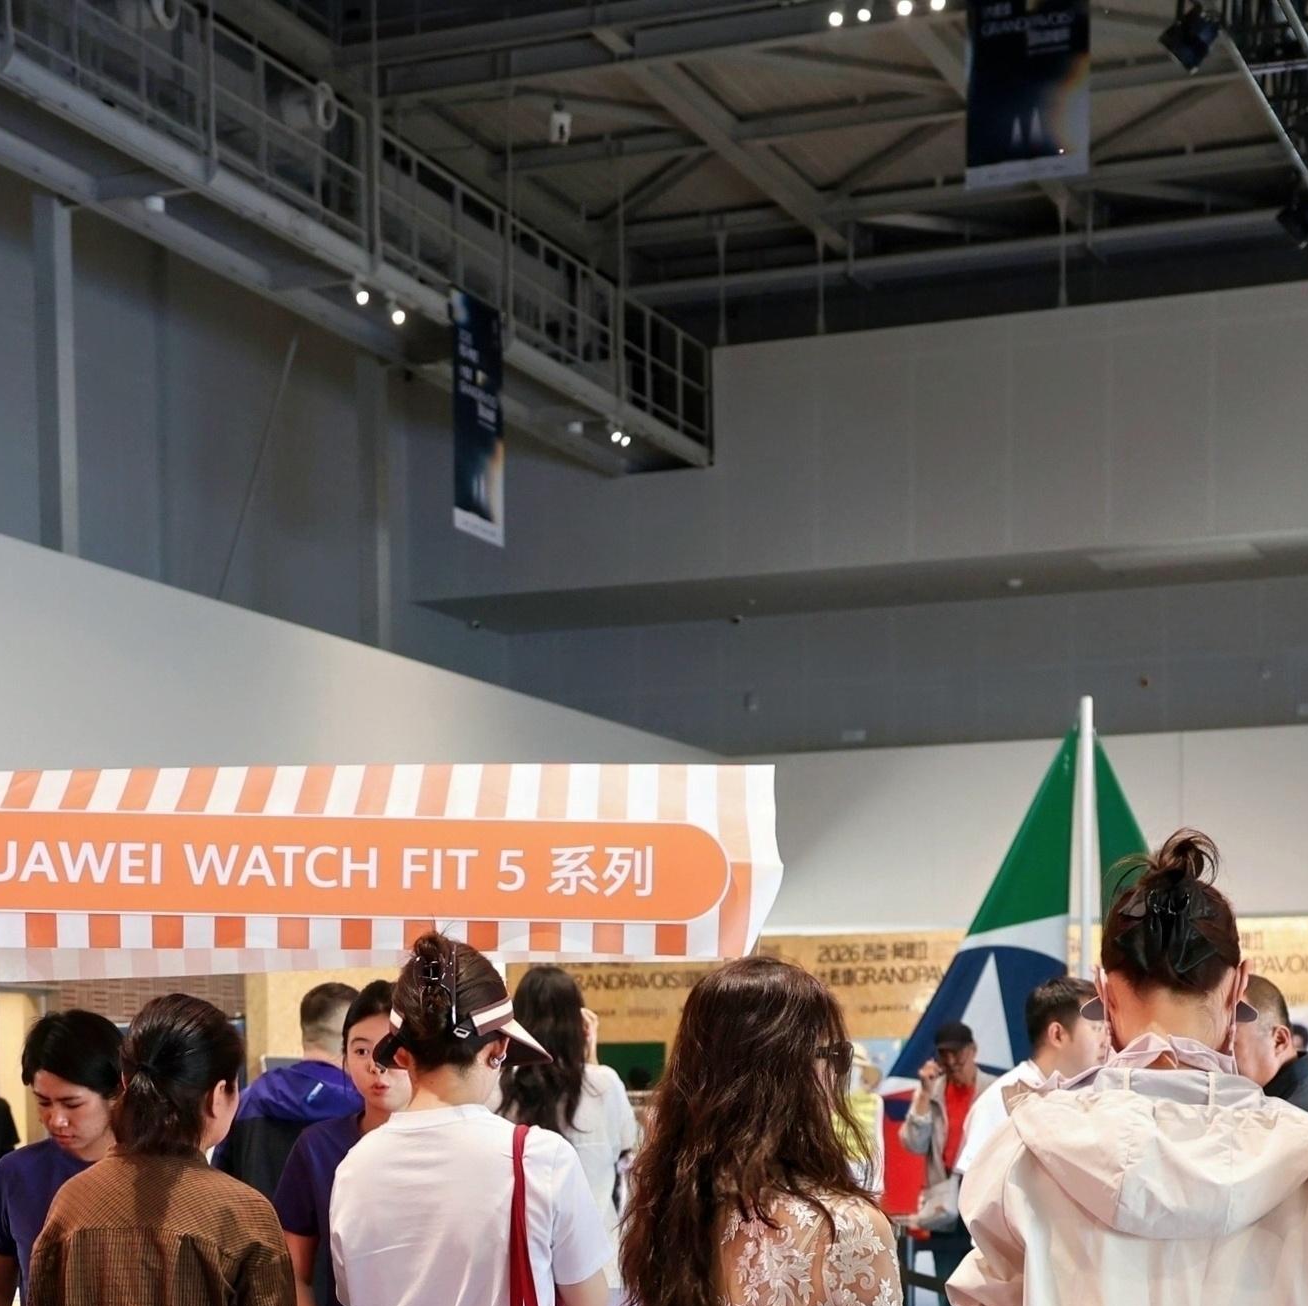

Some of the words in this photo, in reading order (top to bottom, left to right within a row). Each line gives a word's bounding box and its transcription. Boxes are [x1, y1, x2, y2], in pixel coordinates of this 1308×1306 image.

[184, 844, 378, 889] WATCH
[402, 848, 479, 891] FIT
[498, 849, 525, 892] 5
[548, 845, 653, 897] 系列
[818, 944, 860, 963] 2026
